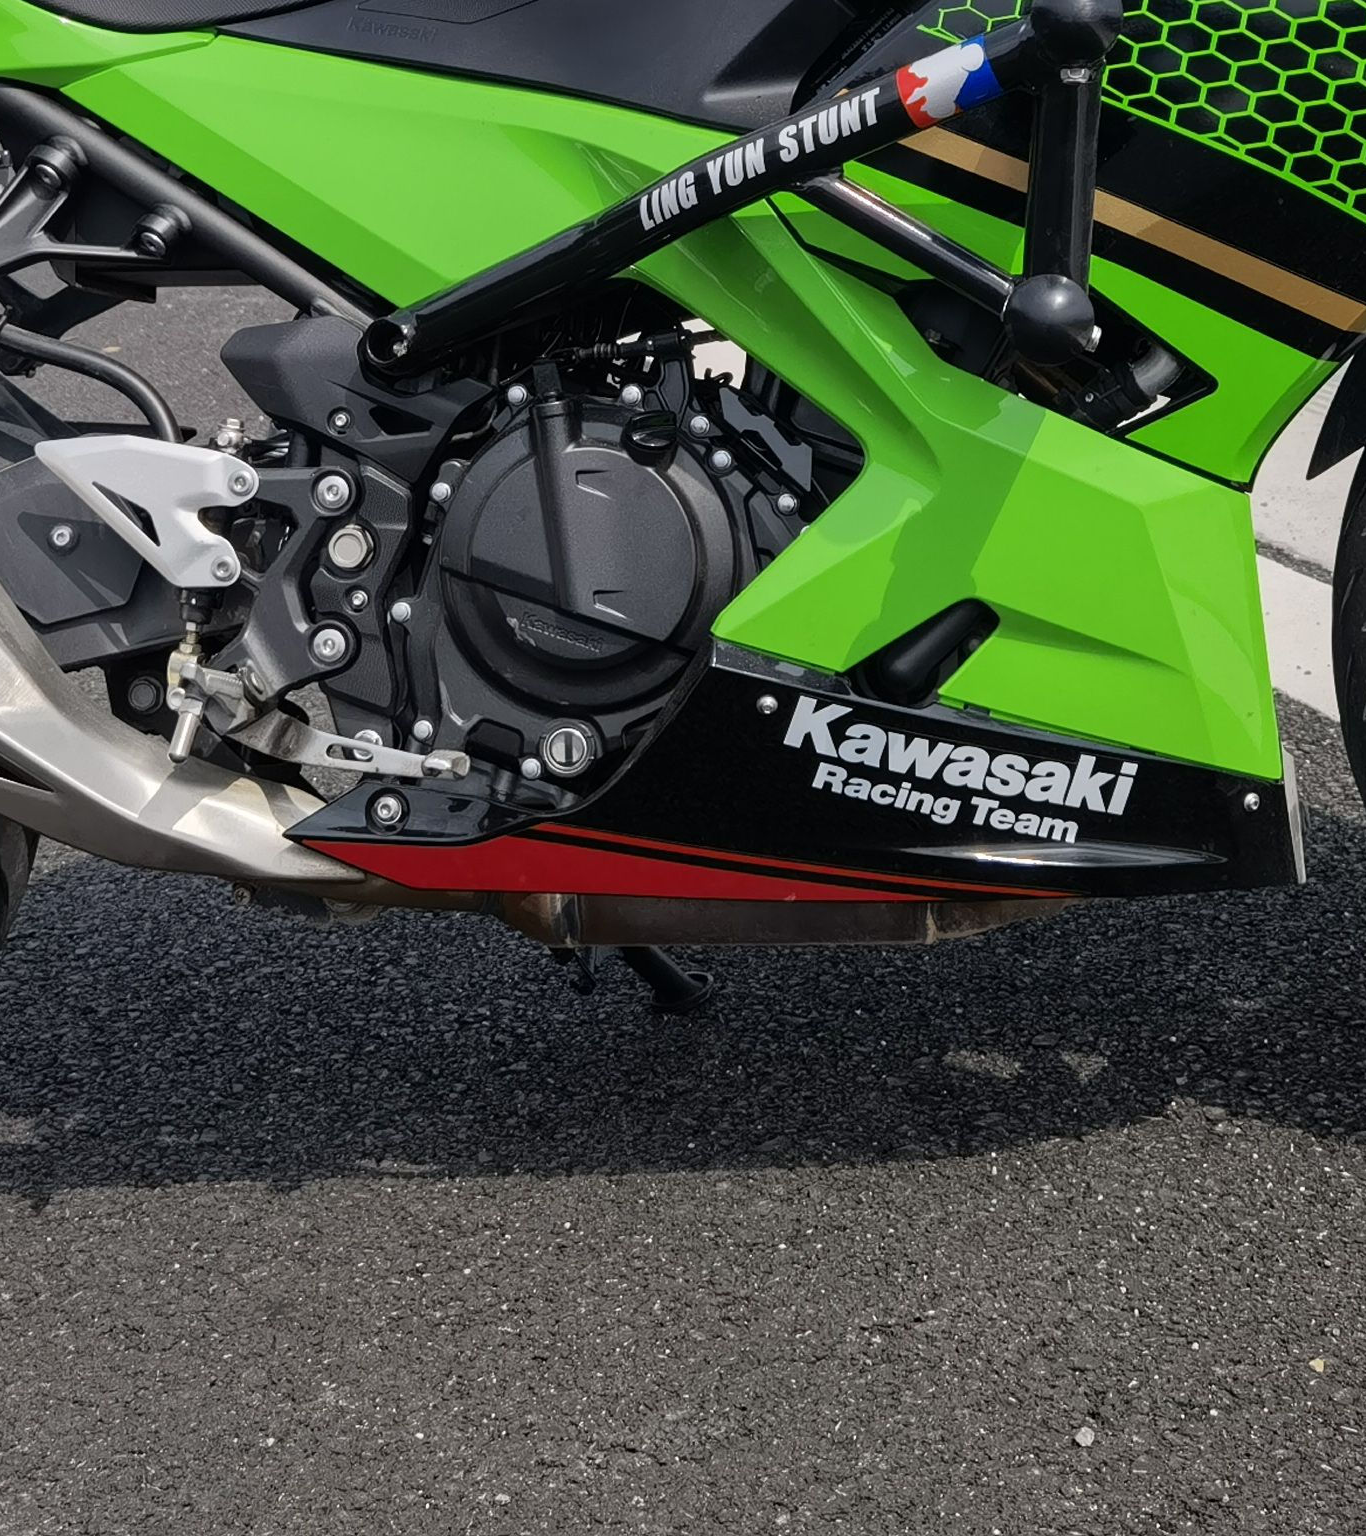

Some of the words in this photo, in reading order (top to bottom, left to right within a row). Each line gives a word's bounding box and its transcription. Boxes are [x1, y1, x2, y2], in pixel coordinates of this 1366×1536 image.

[346, 14, 440, 44] Kawasaki
[639, 170, 699, 232] LING
[705, 136, 767, 196] YUN
[778, 86, 881, 163] STUNT
[520, 611, 605, 654] Kawasaki
[783, 695, 1139, 816] Kawasaki
[811, 762, 962, 825] Racing
[970, 796, 1079, 844] Team
